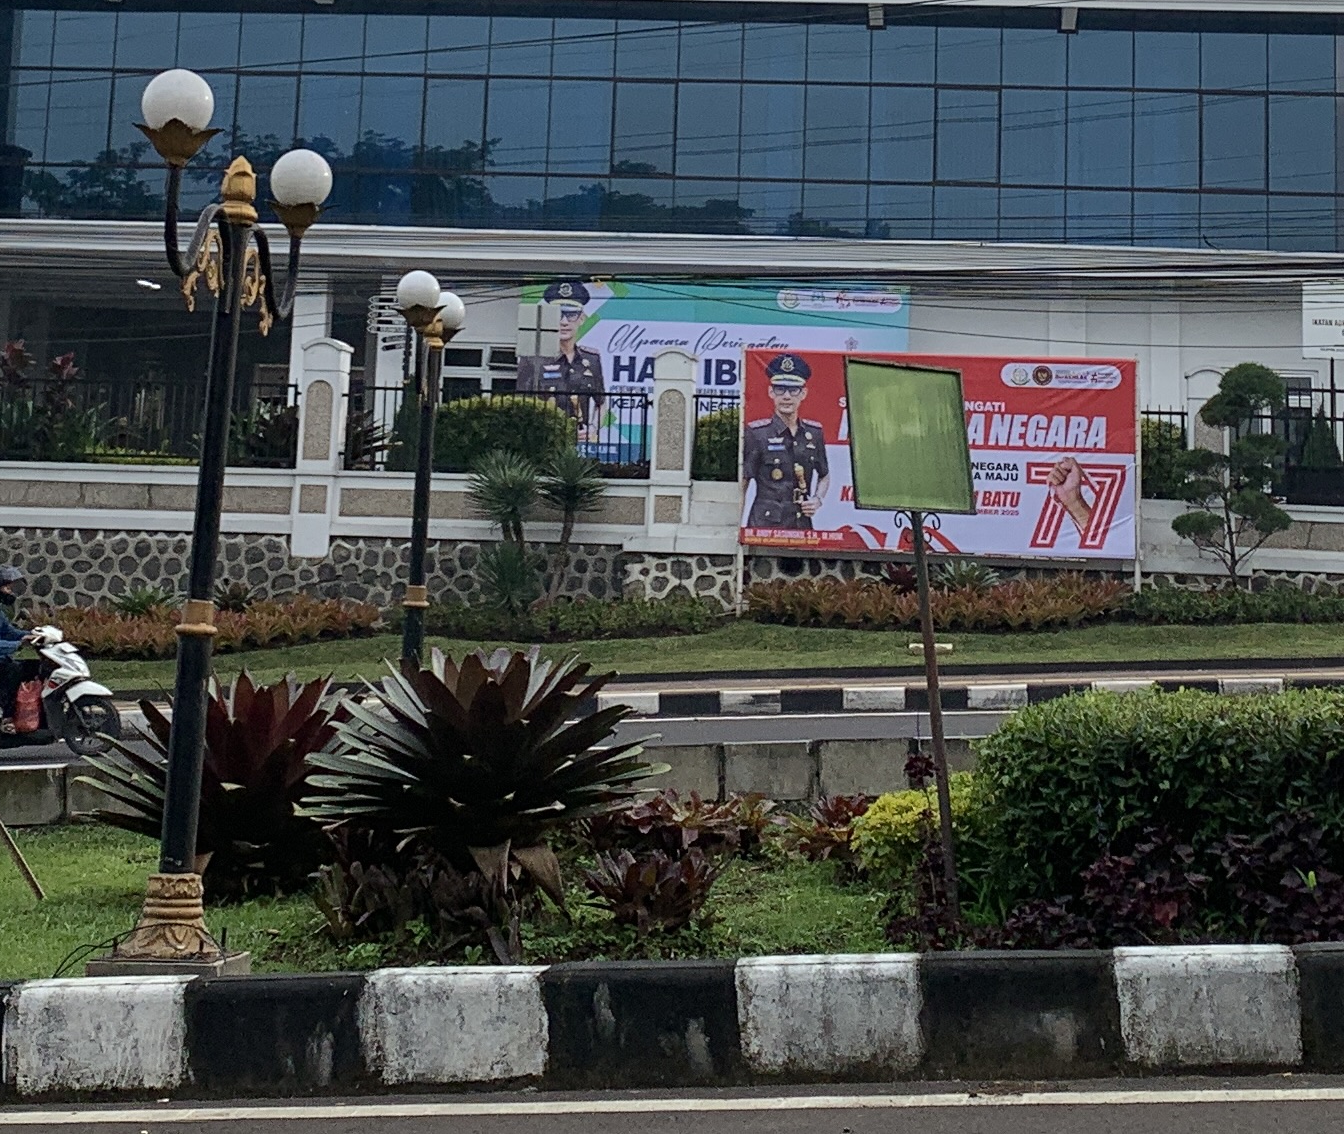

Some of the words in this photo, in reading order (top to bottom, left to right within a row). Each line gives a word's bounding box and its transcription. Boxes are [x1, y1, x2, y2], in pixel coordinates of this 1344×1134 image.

[612, 355, 656, 383] HA
[703, 358, 742, 386] IB
[987, 413, 1106, 449] NEGARA
[971, 461, 1019, 472] NEGARA
[985, 472, 1019, 482] MAJU
[981, 490, 1021, 508] BATU
